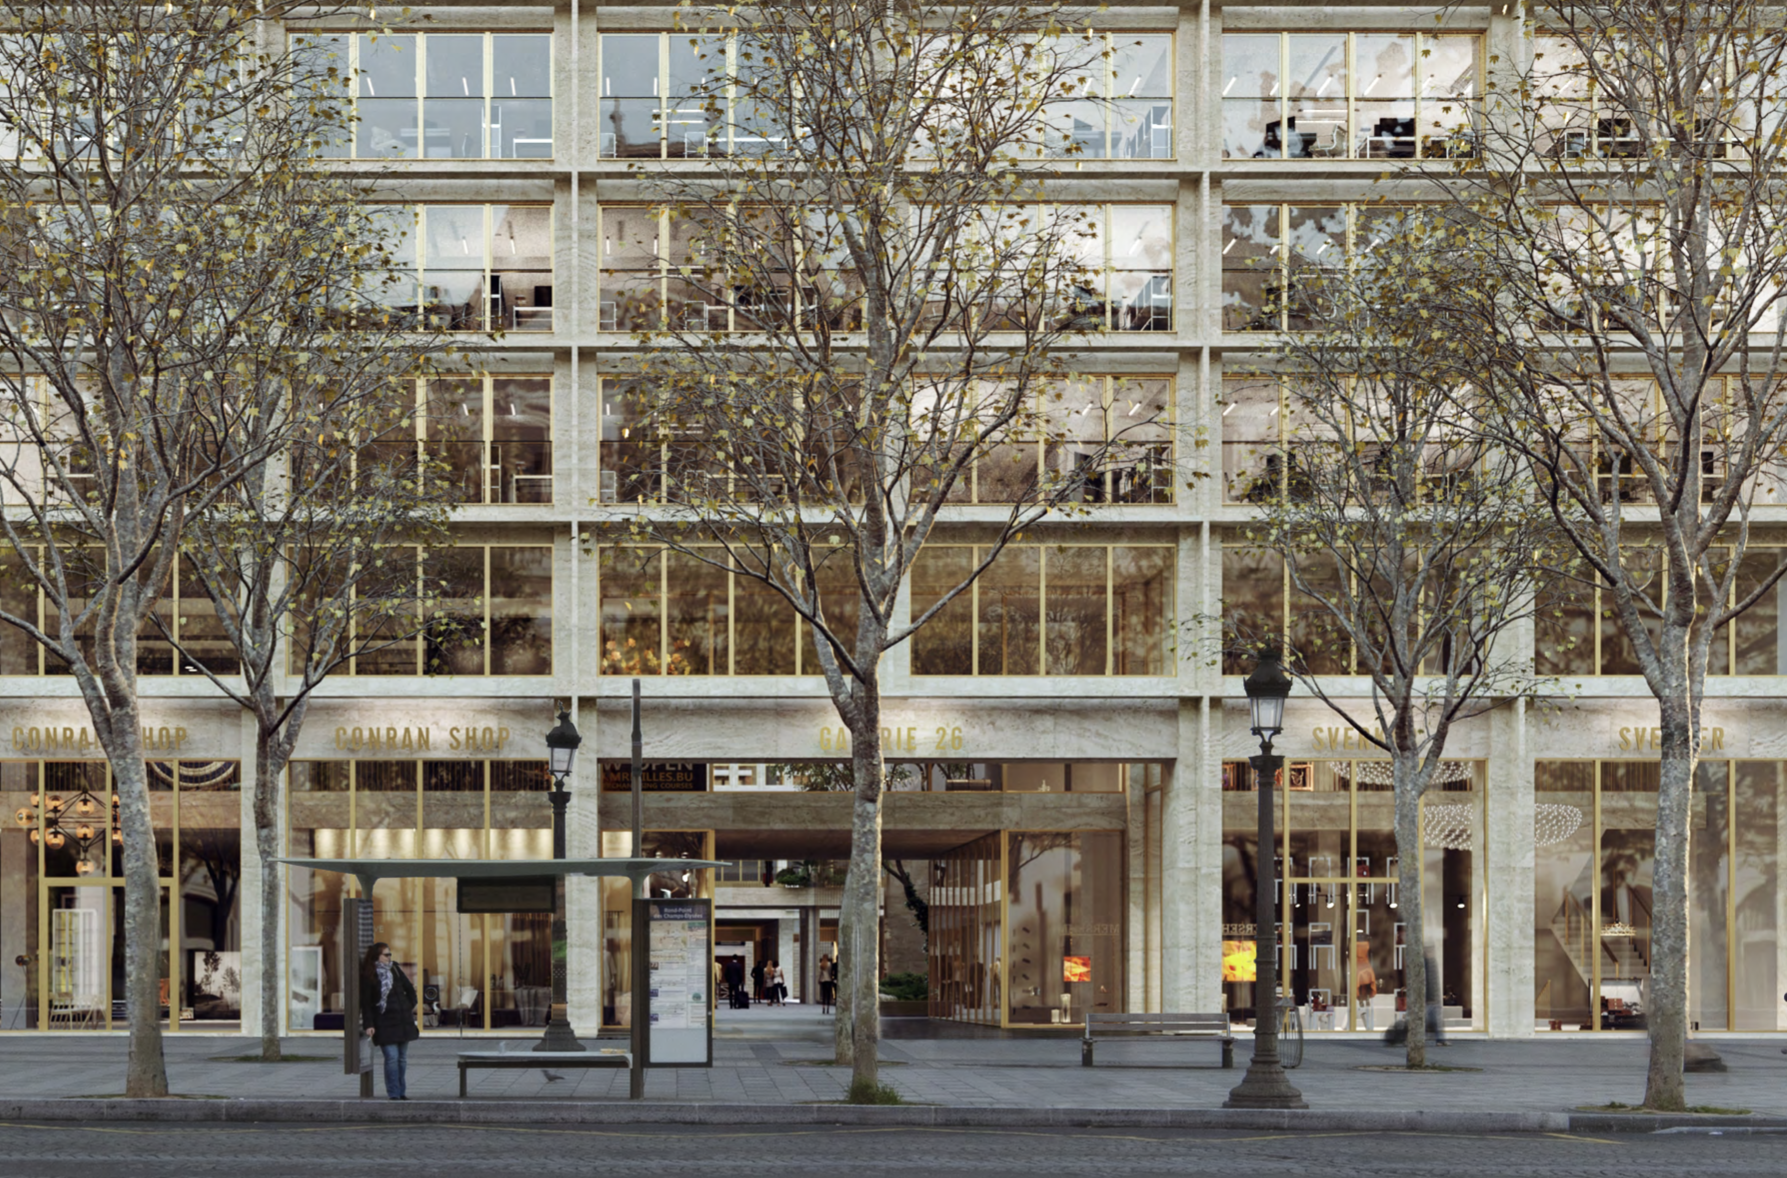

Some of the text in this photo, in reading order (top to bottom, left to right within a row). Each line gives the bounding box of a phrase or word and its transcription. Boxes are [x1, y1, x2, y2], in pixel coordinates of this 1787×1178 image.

[142, 726, 187, 751] HOP
[335, 726, 511, 751] CONRAN SHOP
[819, 726, 963, 751] GARIE 26
[1312, 726, 1417, 751] SVERK
[1618, 726, 1725, 751] SVEER
